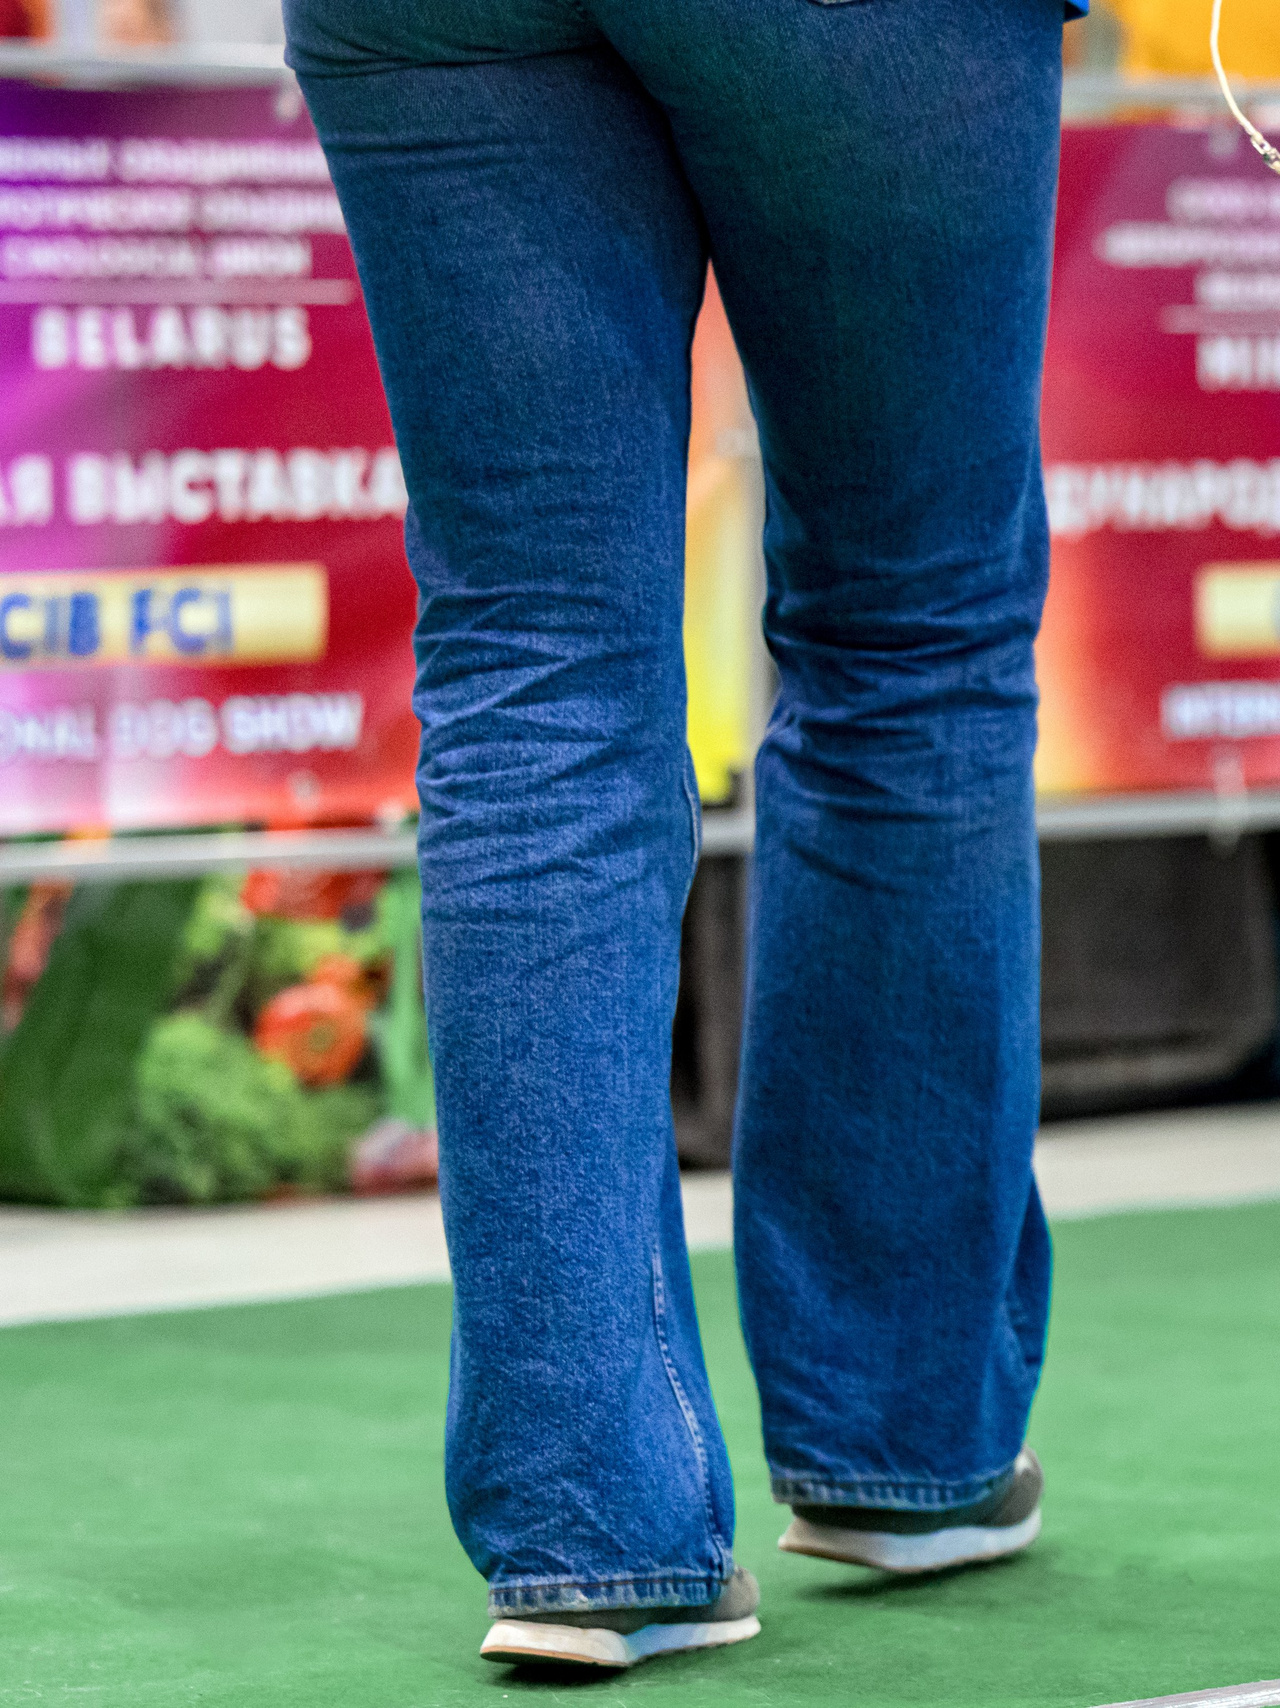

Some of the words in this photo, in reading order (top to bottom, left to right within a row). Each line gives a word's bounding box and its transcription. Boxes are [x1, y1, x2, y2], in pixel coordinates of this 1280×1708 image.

[34, 306, 311, 370] BELARUS
[68, 447, 406, 524] ВЫСТАВКА
[131, 588, 234, 656] FCI
[222, 694, 364, 754] SHOW
